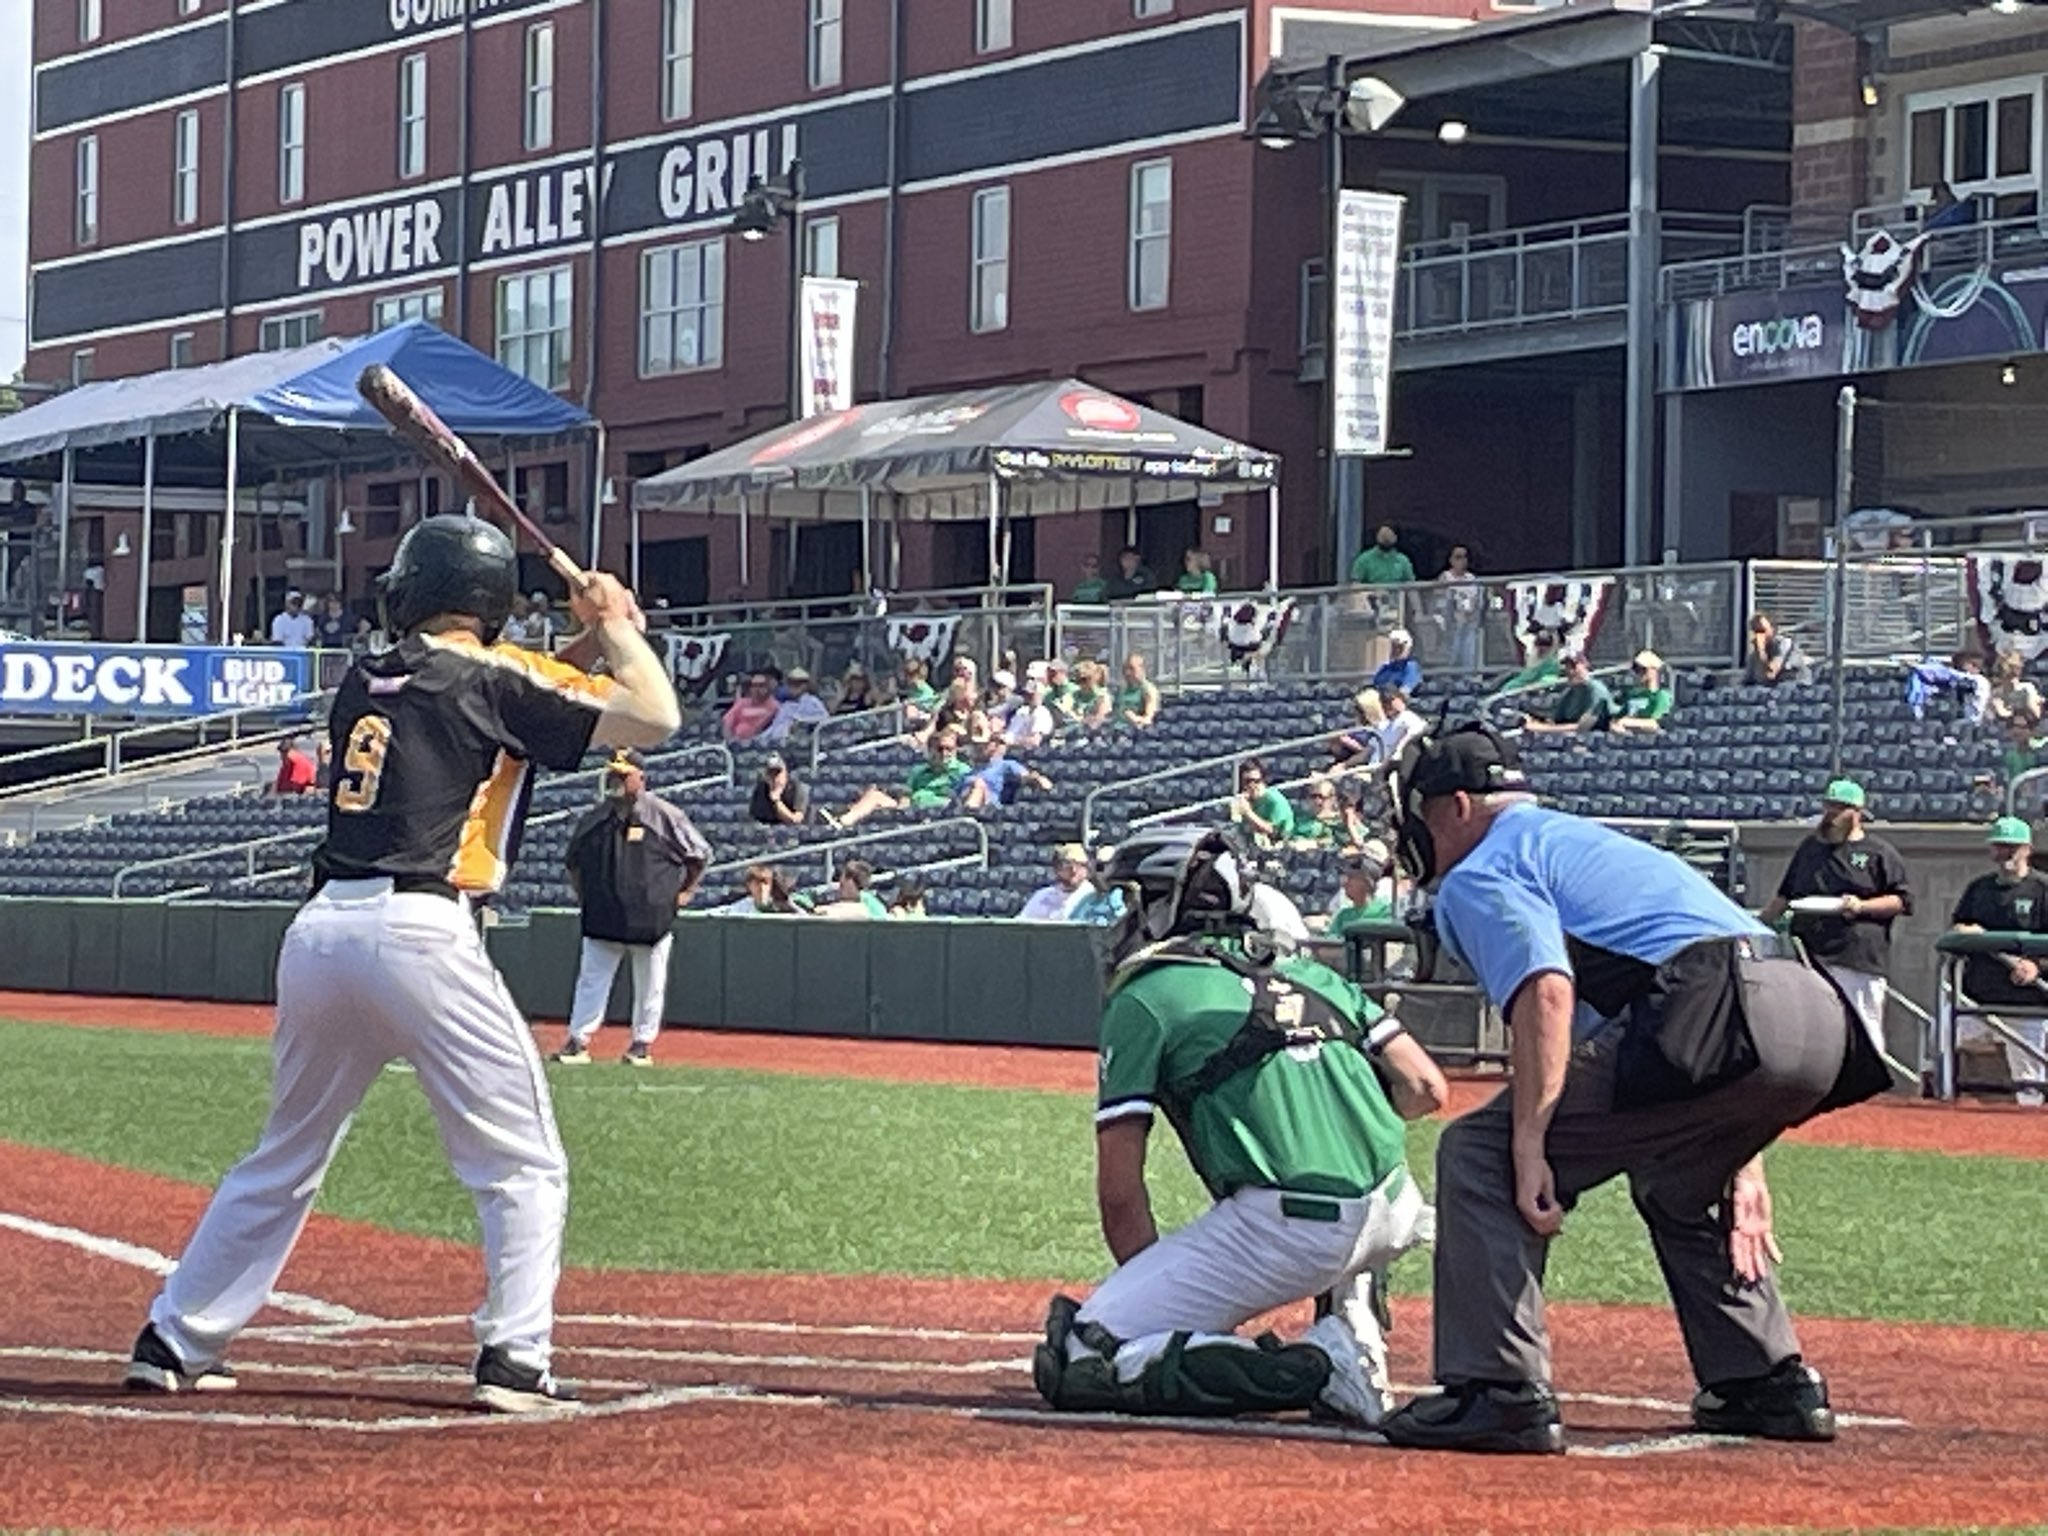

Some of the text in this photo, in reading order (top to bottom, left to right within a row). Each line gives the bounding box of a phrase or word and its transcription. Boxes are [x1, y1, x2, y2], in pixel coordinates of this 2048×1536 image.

[299, 199, 442, 287] POWER
[482, 161, 615, 253] ALLEY
[1, 652, 193, 704] DECK
[212, 680, 297, 706] LIGHT
[223, 658, 286, 682] BUD
[336, 714, 393, 812] 9
